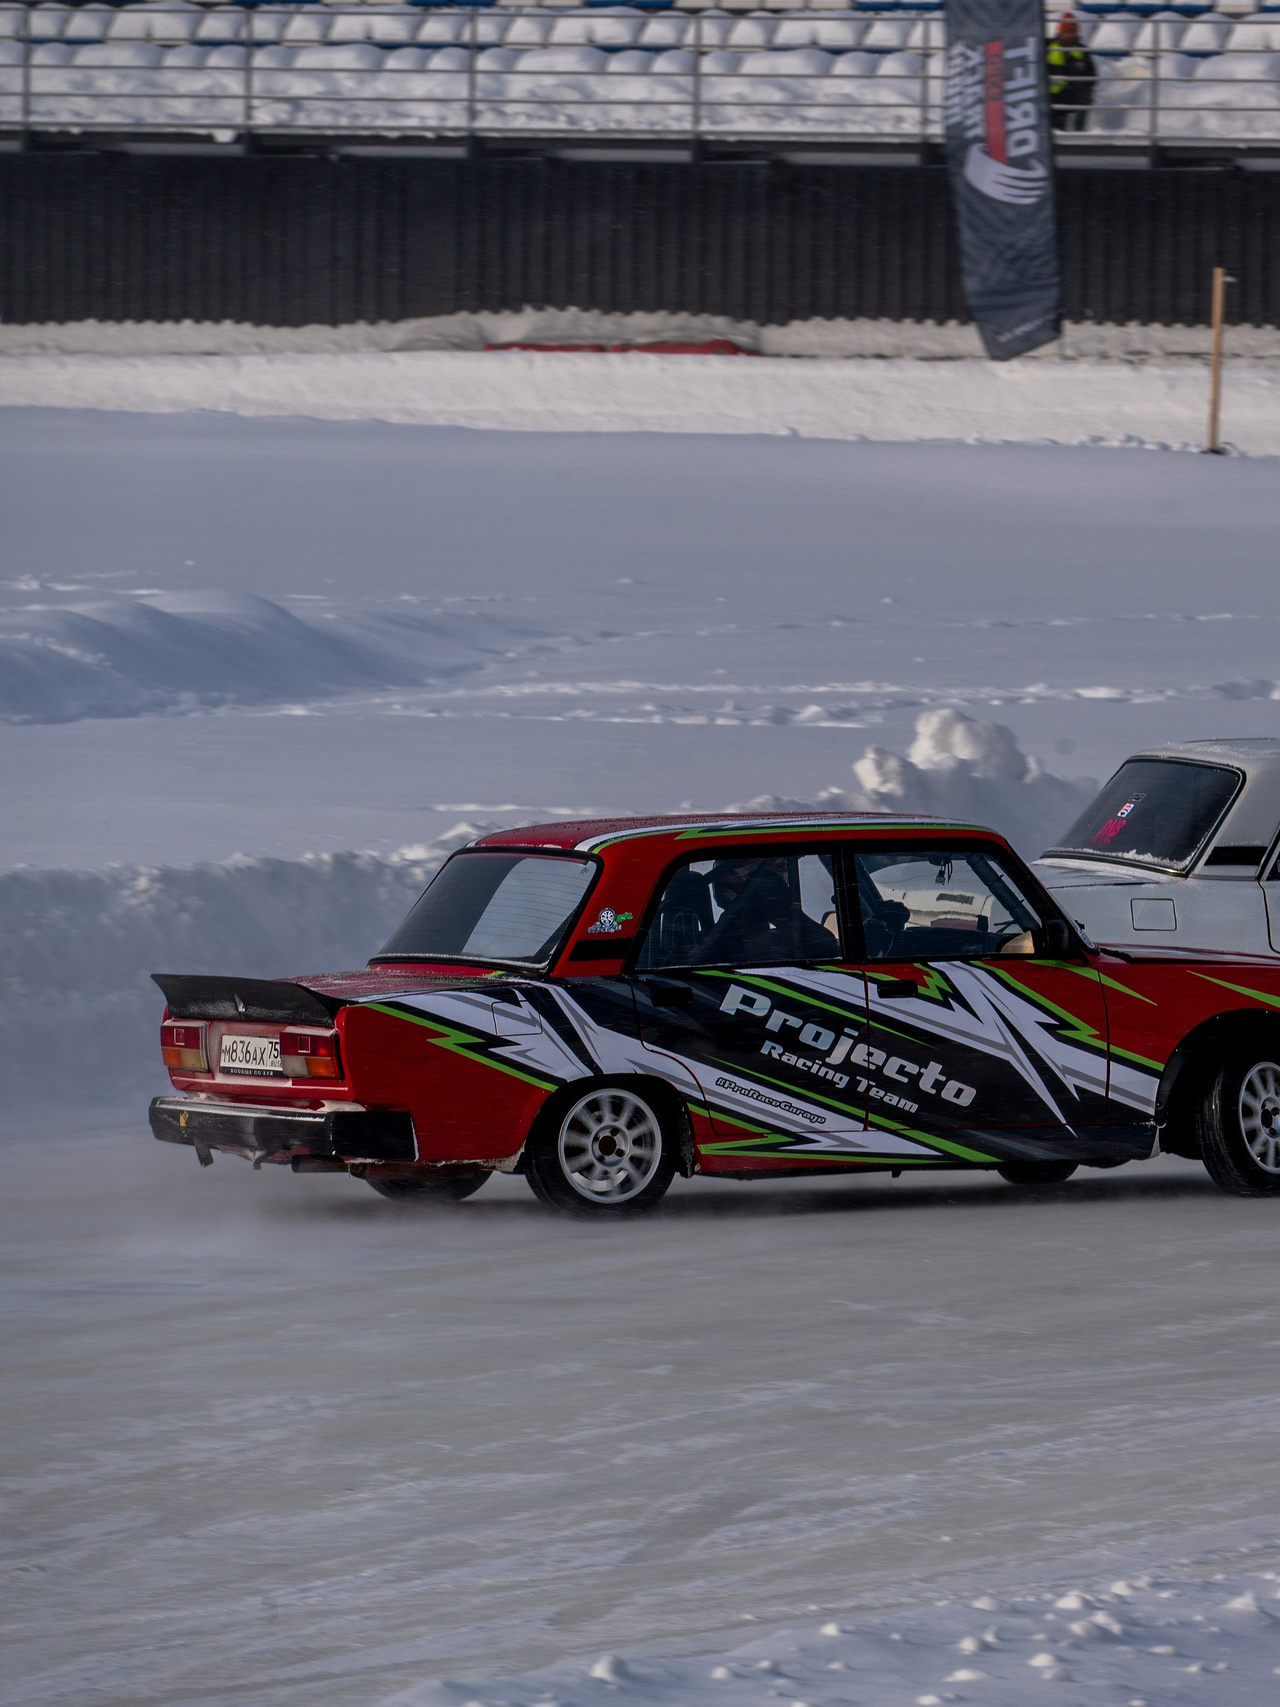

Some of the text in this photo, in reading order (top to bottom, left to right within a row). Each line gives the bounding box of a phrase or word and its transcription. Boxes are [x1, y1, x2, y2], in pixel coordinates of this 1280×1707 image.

[719, 984, 976, 1107] Projecto
[760, 1040, 919, 1114] Racing Team
